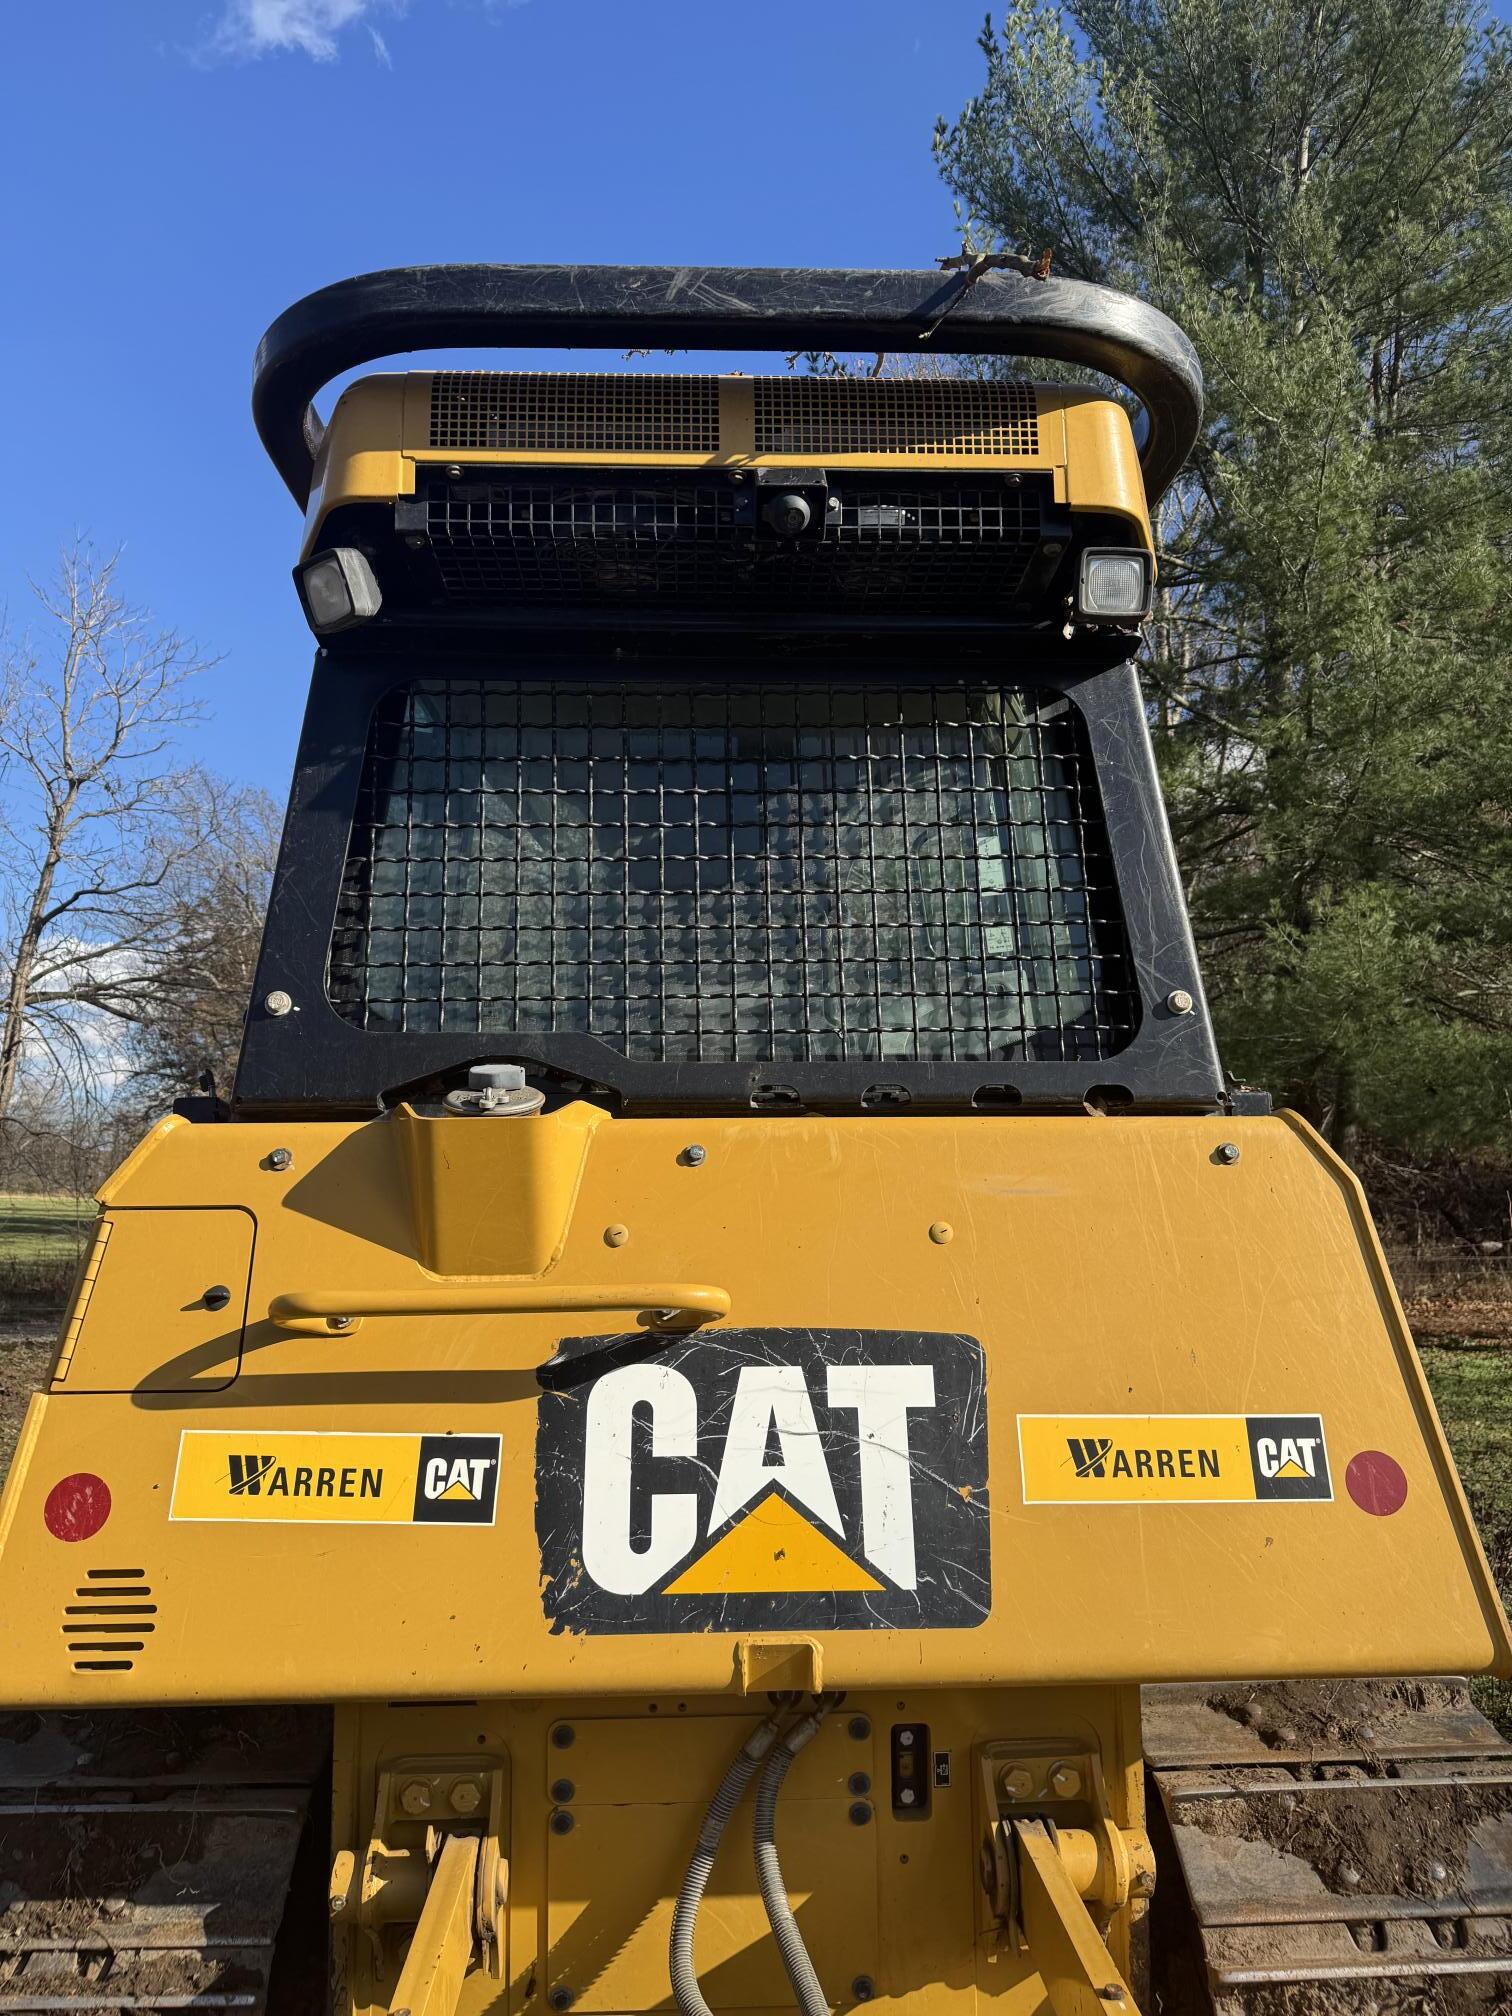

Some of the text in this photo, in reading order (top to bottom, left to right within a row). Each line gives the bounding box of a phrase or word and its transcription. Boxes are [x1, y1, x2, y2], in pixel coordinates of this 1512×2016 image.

[227, 1455, 491, 1500] WARREN CAT
[582, 1363, 936, 1595] CAT
[1066, 1437, 1317, 1478] WARREN CAT
